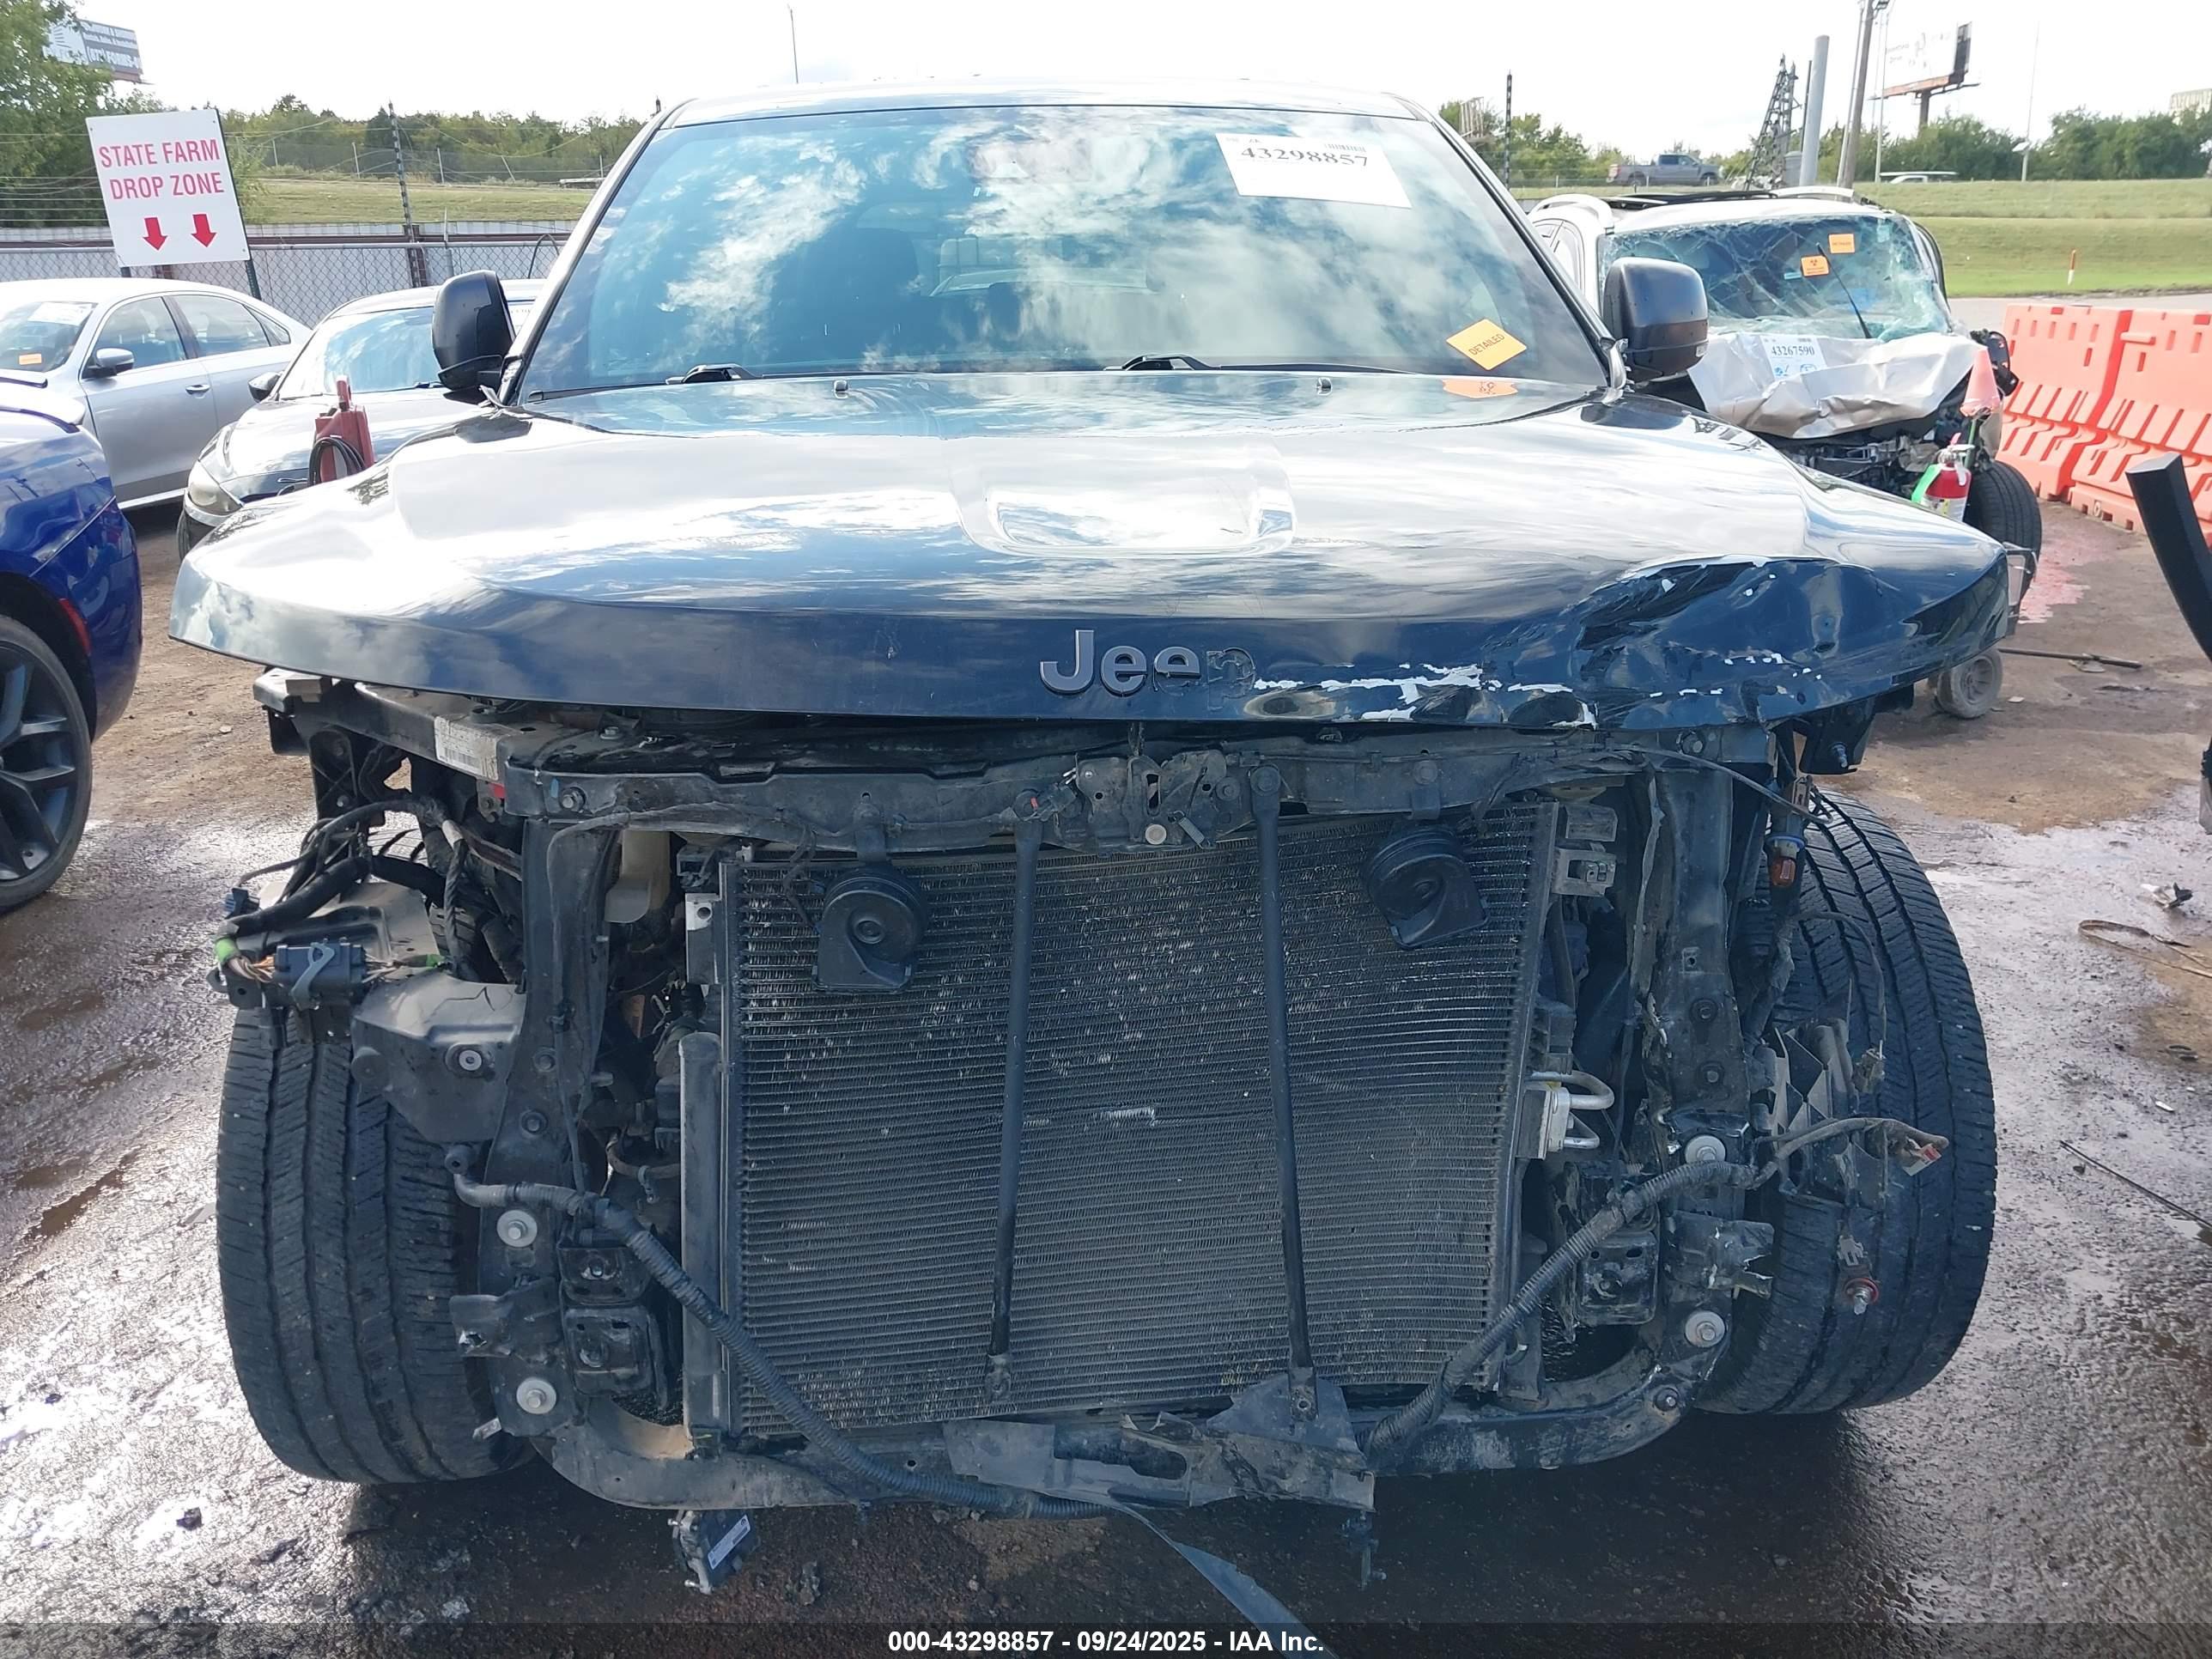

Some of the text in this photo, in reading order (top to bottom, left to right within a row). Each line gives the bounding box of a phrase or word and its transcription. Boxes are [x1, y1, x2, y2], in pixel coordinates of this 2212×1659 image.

[99, 139, 221, 168] STATE FARM
[1241, 147, 1368, 167] 43298857
[109, 172, 225, 200] DROP ZONE
[1468, 333, 1505, 356] DETAILED
[1771, 345, 1815, 356] 43267590
